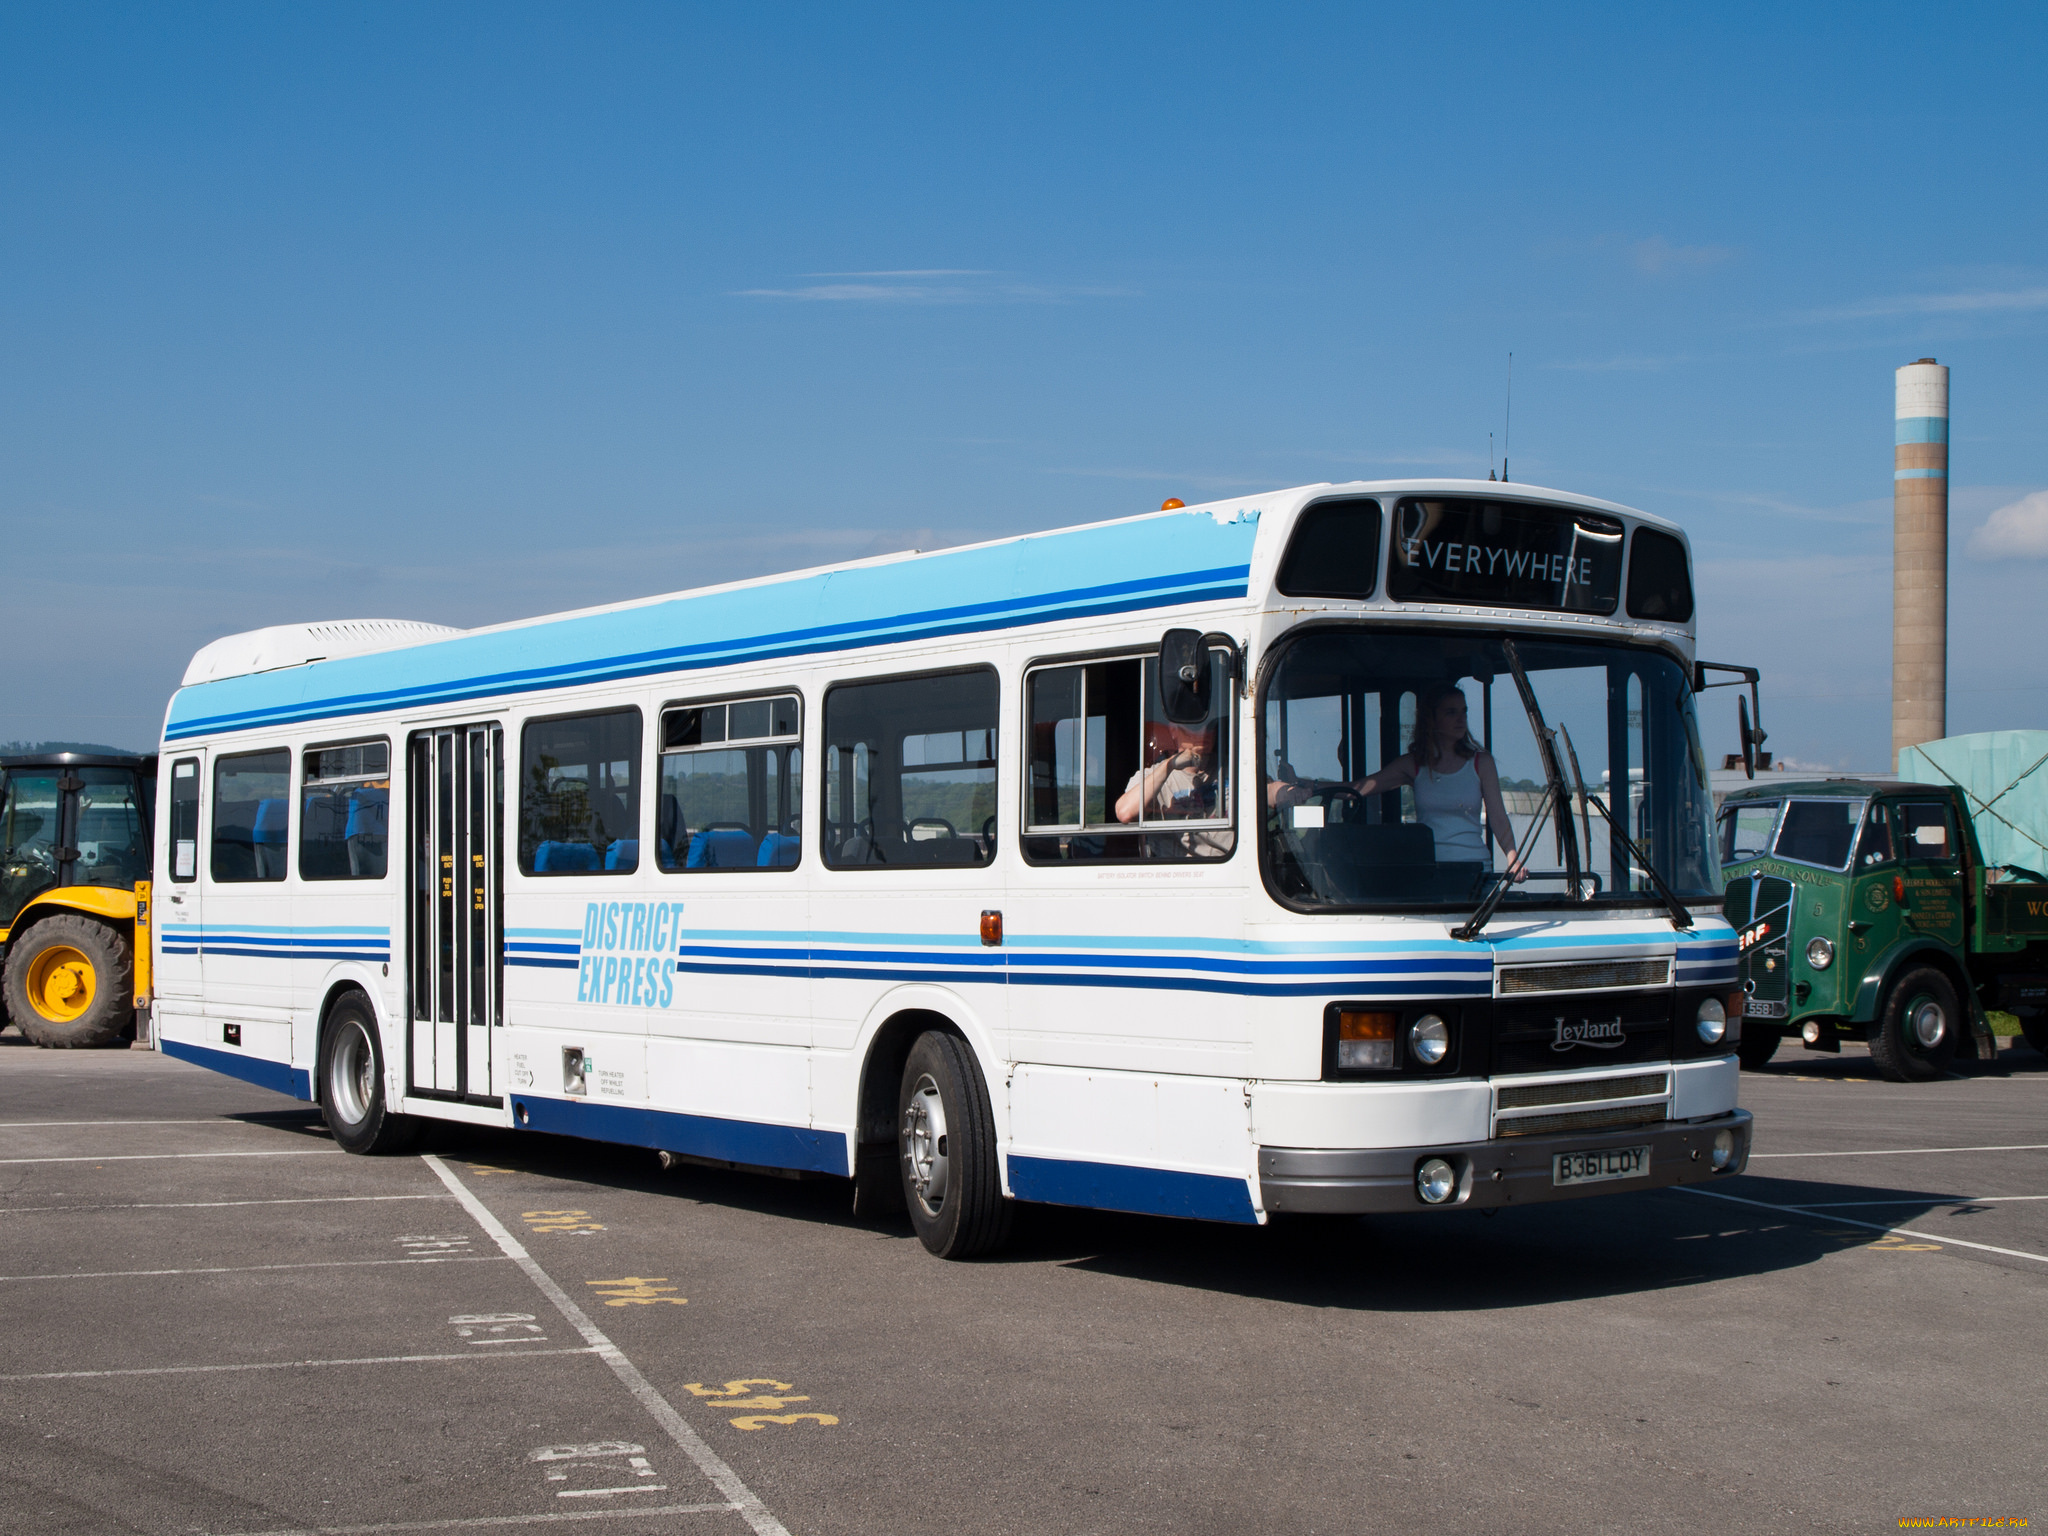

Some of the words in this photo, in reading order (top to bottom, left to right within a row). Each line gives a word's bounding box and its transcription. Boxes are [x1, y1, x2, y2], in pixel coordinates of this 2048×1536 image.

[1407, 538, 1592, 585] EVERYWHERE
[1795, 870, 1816, 884] SON
[1813, 902, 1823, 917] 5
[583, 901, 684, 952] DISTRICT
[1739, 923, 1767, 951] ERF
[1858, 938, 1866, 950] 5
[577, 955, 676, 1008] EXPRESS
[1749, 1003, 1770, 1014] 558
[1552, 1016, 1626, 1050] Leyland
[683, 1378, 839, 1431] 345
